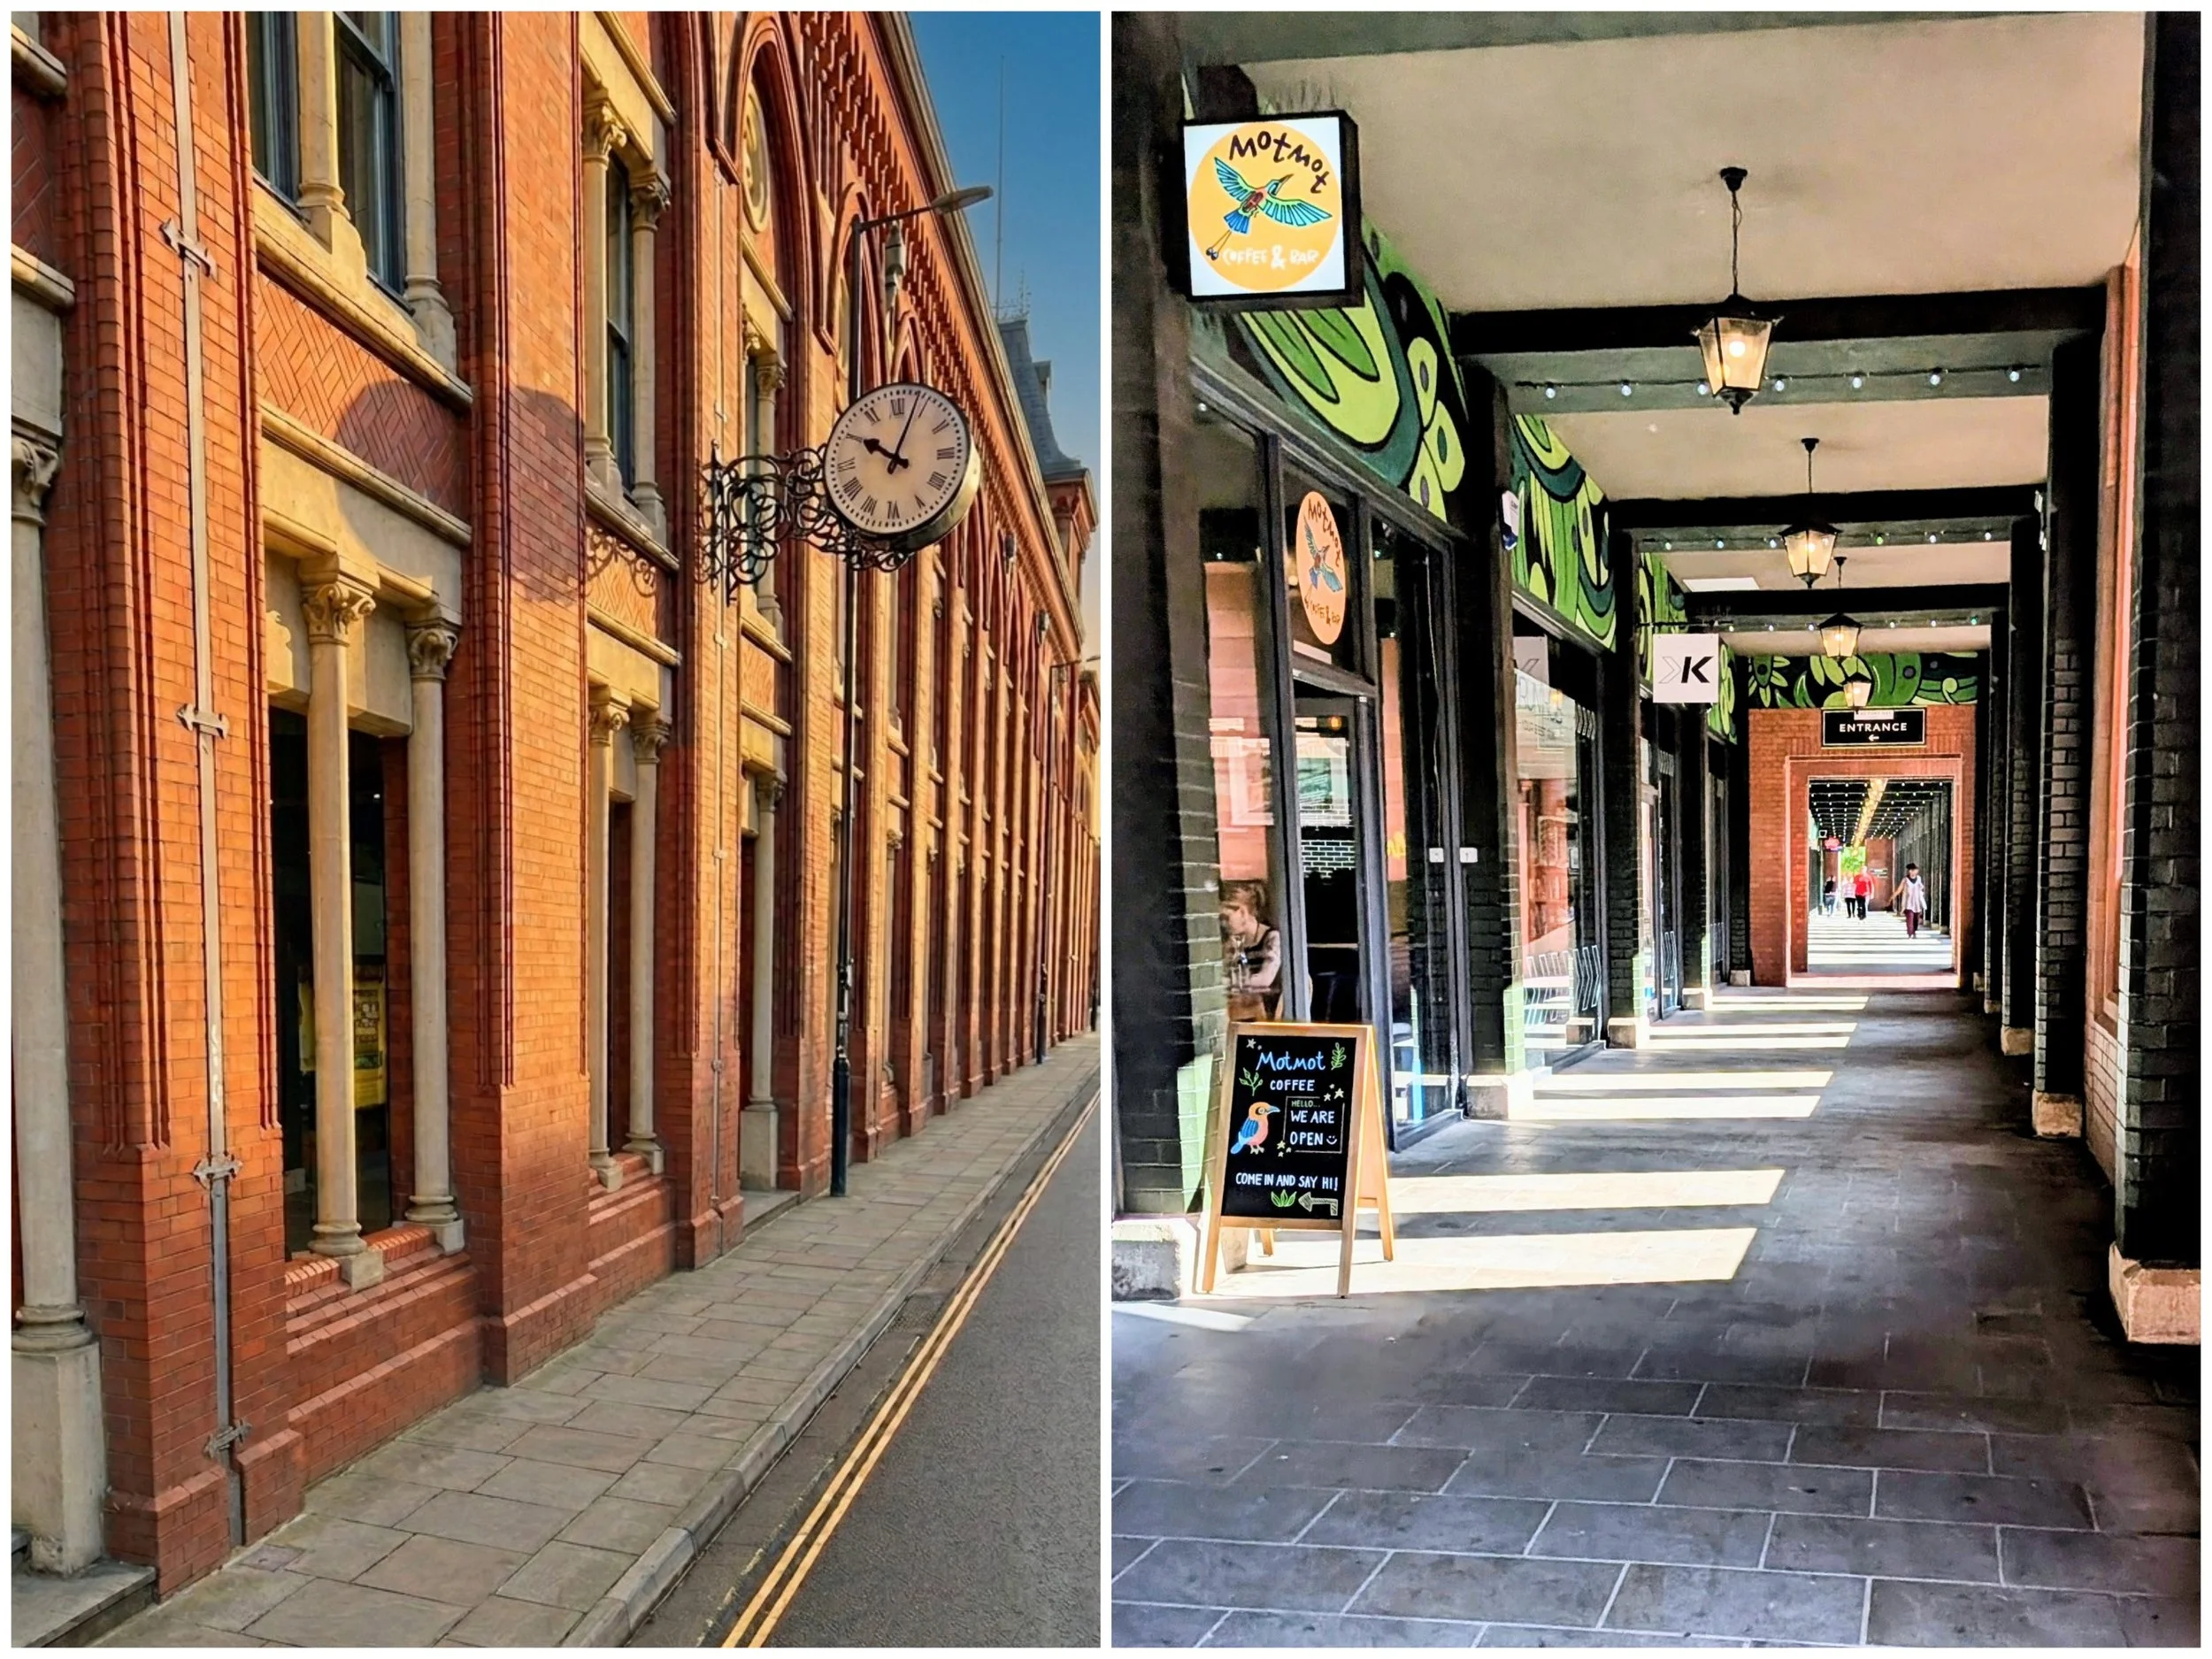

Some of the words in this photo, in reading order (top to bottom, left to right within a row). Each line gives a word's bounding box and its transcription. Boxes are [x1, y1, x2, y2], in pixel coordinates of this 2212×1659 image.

[1222, 248, 1267, 265] COFFEE
[1271, 244, 1286, 270] &
[1289, 249, 1319, 265] BAR
[1839, 722, 1908, 733] ENTRANCE
[1270, 1079, 1315, 1092] COFFEE
[1290, 1110, 1307, 1124] WE
[1310, 1110, 1335, 1124] ARE
[1290, 1132, 1324, 1146] OPEN
[1235, 1172, 1262, 1186] COME
[1263, 1174, 1275, 1186] IN
[1276, 1173, 1295, 1187] AND
[1298, 1175, 1318, 1189] SAY
[1322, 1177, 1339, 1191] HI!
